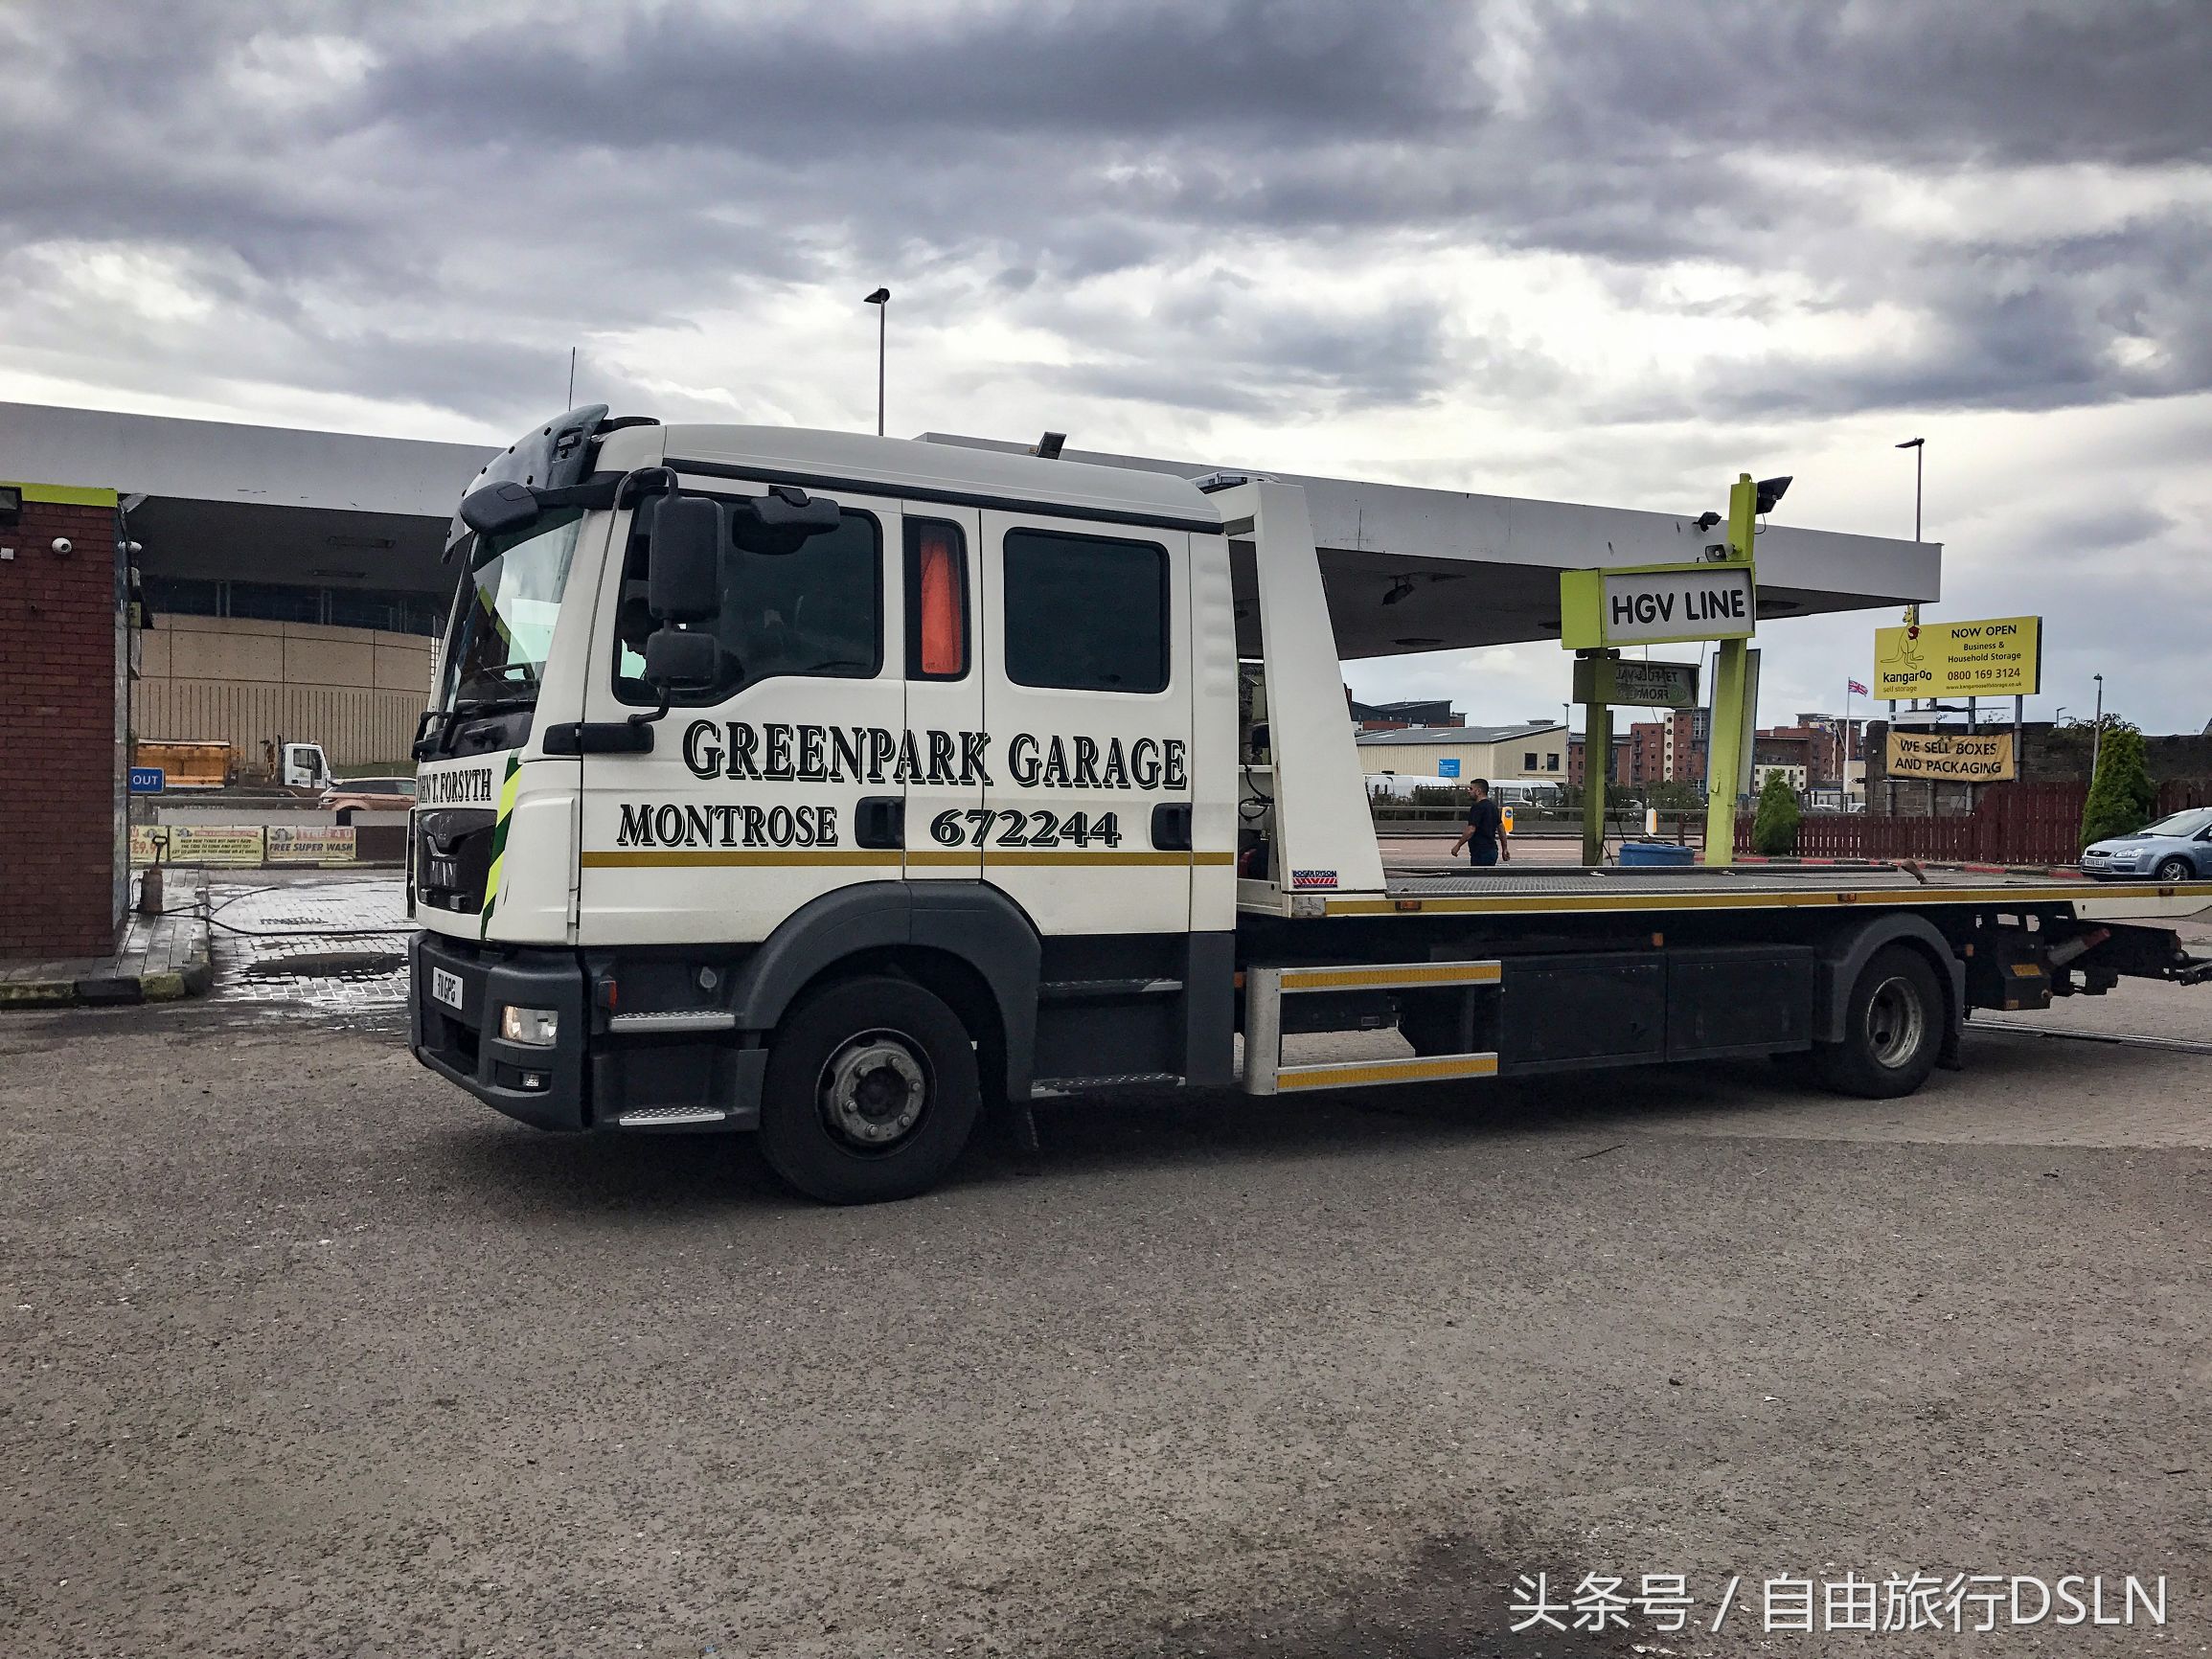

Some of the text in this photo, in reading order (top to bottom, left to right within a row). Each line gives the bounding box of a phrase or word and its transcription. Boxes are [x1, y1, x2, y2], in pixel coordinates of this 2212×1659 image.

[1611, 589, 1745, 625] HGV LINE
[1950, 625, 2018, 639] NOW OPEN
[1964, 643, 1996, 651] Business
[1948, 652, 2021, 663] Household Storage
[1882, 670, 1932, 685] kangaroo
[1947, 668, 2021, 681] 0800 169 3124
[682, 719, 1188, 790] GREENPARK GARAGE
[1900, 739, 1997, 756] WE SELL BOXES
[1895, 758, 2002, 774] AND PACKAGING
[132, 775, 159, 785] OUT
[440, 768, 492, 804] FORSYTH
[617, 804, 1122, 849] MONTROSE 672244
[269, 843, 353, 852] FREE SUPER WASH
[1292, 870, 1337, 878] ROGER DYSON
